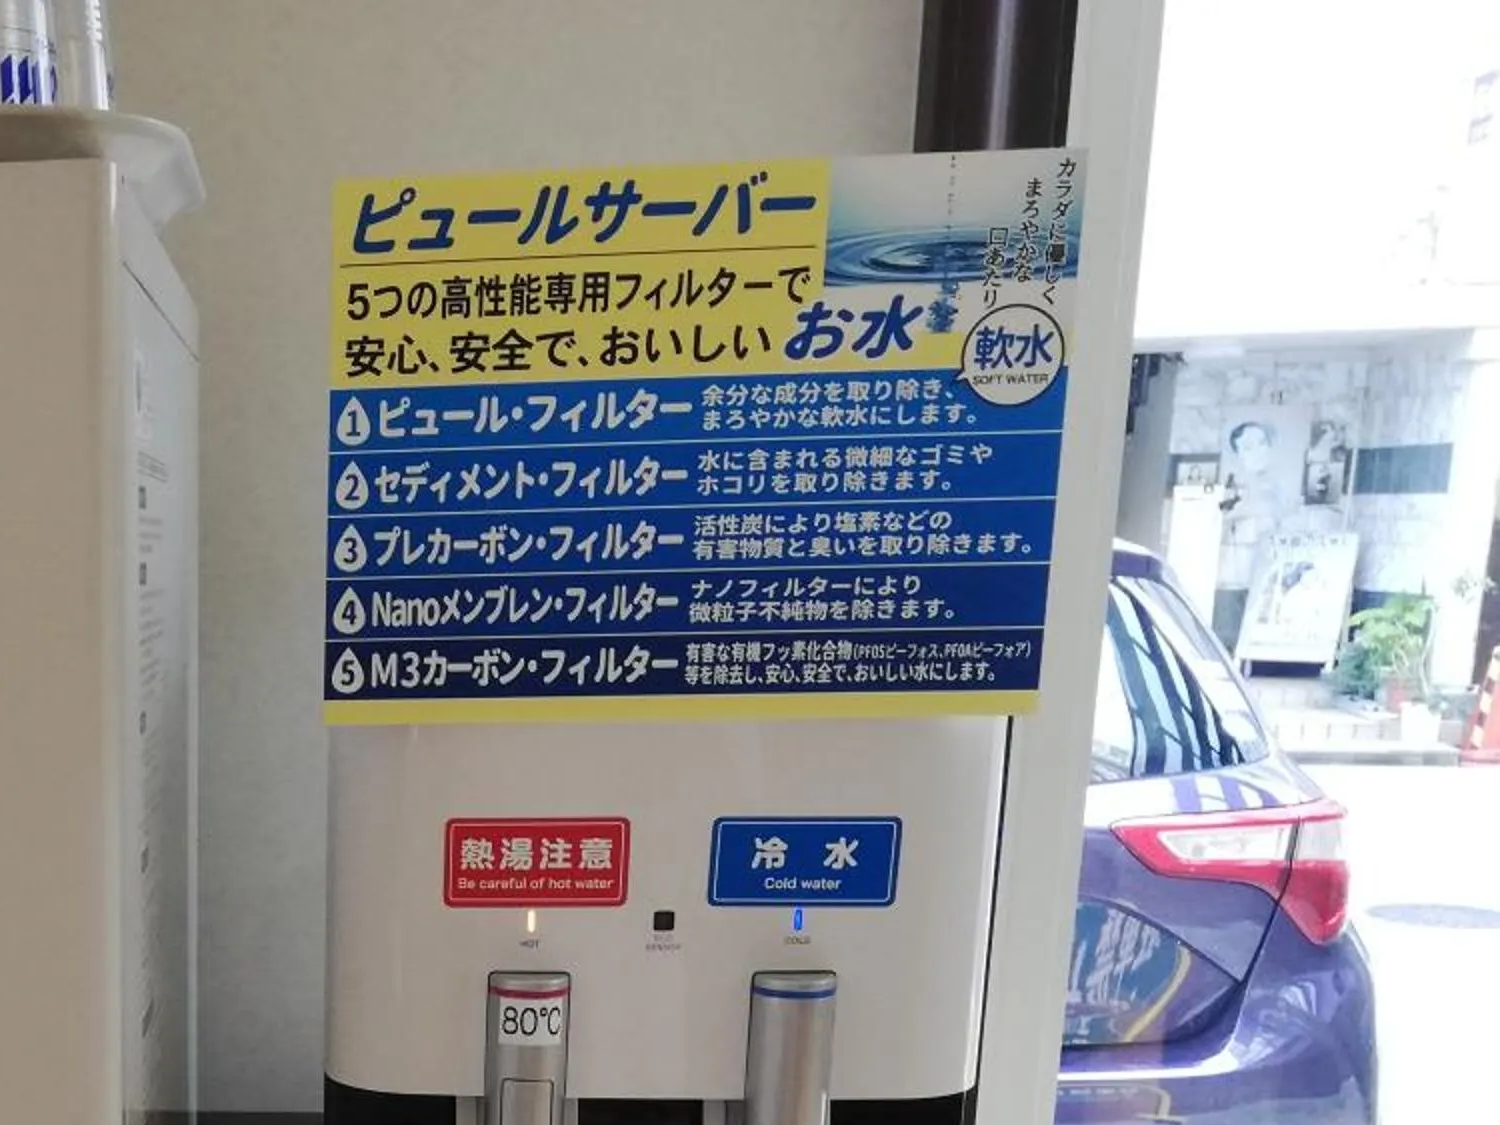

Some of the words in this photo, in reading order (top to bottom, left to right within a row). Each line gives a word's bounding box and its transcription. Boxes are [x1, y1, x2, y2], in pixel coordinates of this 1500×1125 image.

[353, 171, 816, 254] ピュールサーバー
[1014, 177, 1042, 283] まろやかな
[983, 227, 1008, 308] 口あたり
[347, 266, 811, 320] 5つの高性能専用フィルターで
[345, 324, 772, 377] 安心、安全で、おいしい
[784, 294, 924, 359] お水
[974, 323, 1055, 370] 軟水
[702, 379, 955, 407] 余分な成分を取り除き、
[973, 375, 1003, 386] SOFT
[1007, 373, 1050, 385] WATER
[346, 411, 361, 437] 1
[380, 389, 693, 437] ピュール・フィルター
[703, 404, 979, 430] まろやかな軟水にします。
[698, 443, 993, 472] 水に含まれる微細なゴミや
[344, 475, 360, 501] 2
[375, 457, 689, 503] セディメント・フィルター
[697, 470, 951, 496] ホコリを取り除きます。
[694, 511, 953, 537] 活性炭により塩素などの
[343, 537, 358, 564] 3
[373, 521, 684, 566] プレカーボン・フィルター
[694, 532, 1032, 561] 有害物質と臭いを取り除きます。
[691, 575, 921, 600] ナノフィルターにより
[342, 601, 358, 625] 4
[371, 582, 679, 628] Nanoメンブレン・フィルター
[689, 598, 955, 624] 微粒子不純物を除きます。
[341, 662, 355, 687] 5
[371, 645, 679, 688] M3カーボン・フィルター
[460, 837, 613, 871] 熱湯注意
[458, 878, 474, 889] Be
[479, 876, 524, 889] careful
[529, 877, 545, 889] of
[548, 877, 570, 889] hot
[575, 878, 614, 889] water
[764, 876, 796, 890] Cold
[801, 878, 842, 890] water
